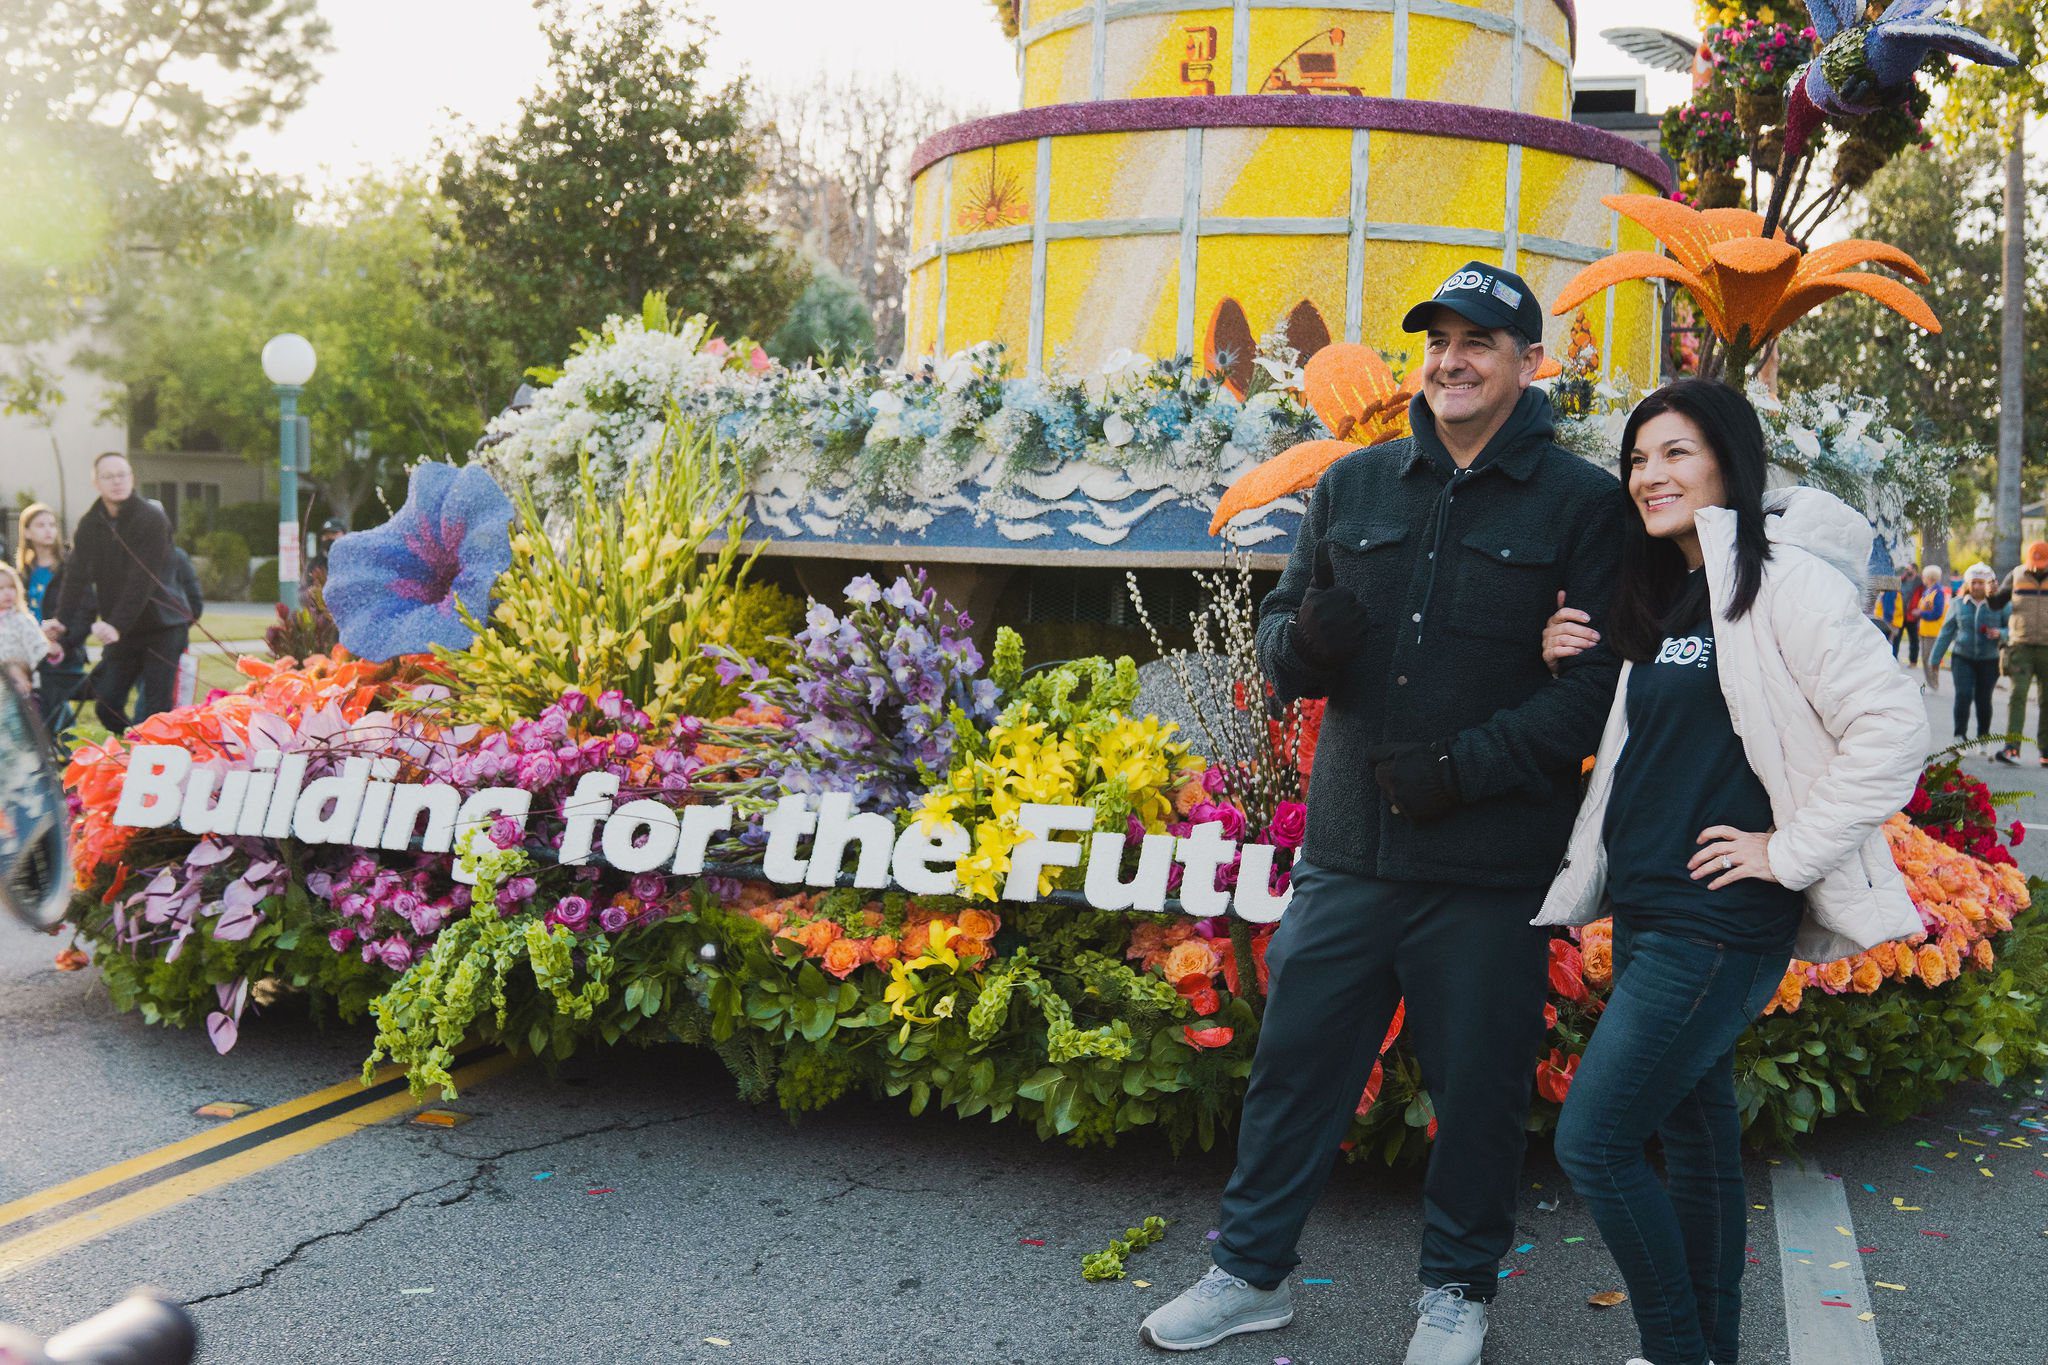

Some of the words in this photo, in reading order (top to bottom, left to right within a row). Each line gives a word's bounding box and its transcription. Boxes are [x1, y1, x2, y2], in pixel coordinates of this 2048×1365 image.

[1478, 274, 1495, 294] YEARS
[1697, 637, 1714, 669] YEARS
[113, 744, 533, 886] Building
[558, 771, 733, 876] for
[762, 791, 971, 896] the
